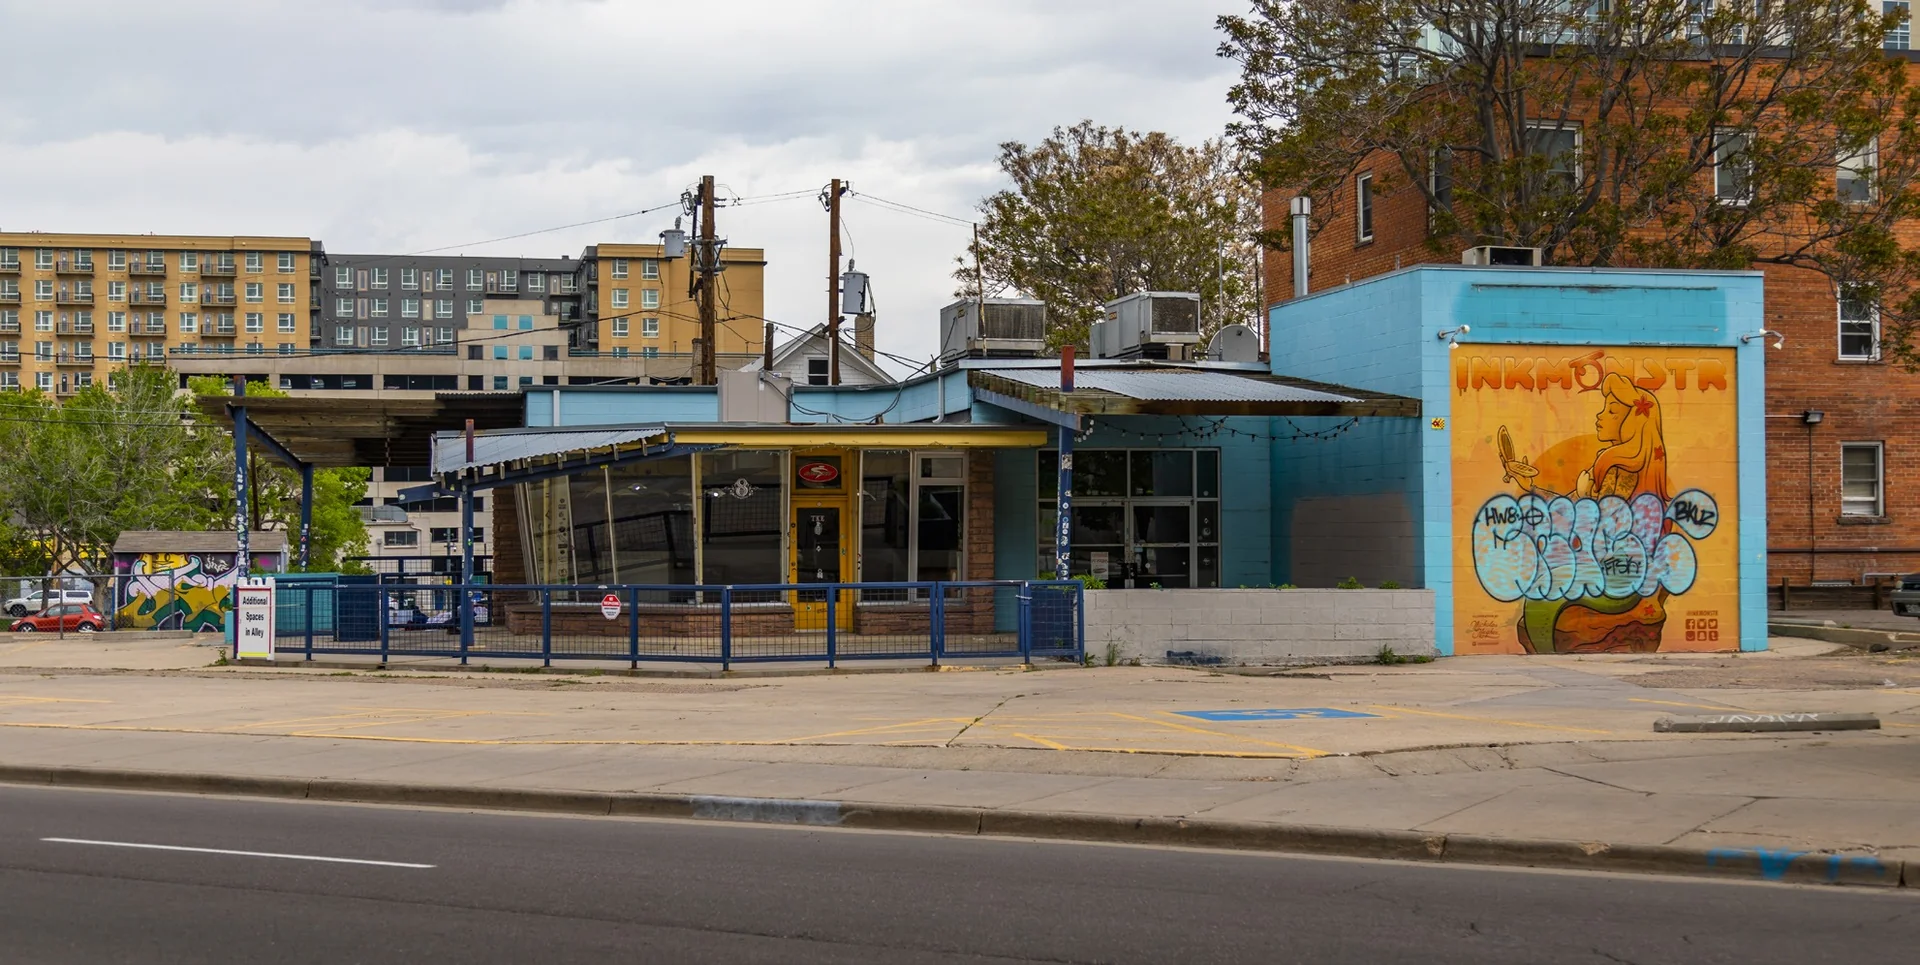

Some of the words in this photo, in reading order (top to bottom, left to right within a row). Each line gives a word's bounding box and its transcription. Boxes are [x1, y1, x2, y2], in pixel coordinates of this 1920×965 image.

[1456, 350, 1727, 394] INKMONSTR
[242, 596, 268, 605] Additional
[245, 611, 264, 622] Spaces
[245, 627, 250, 636] in
[251, 627, 264, 638] Alley
